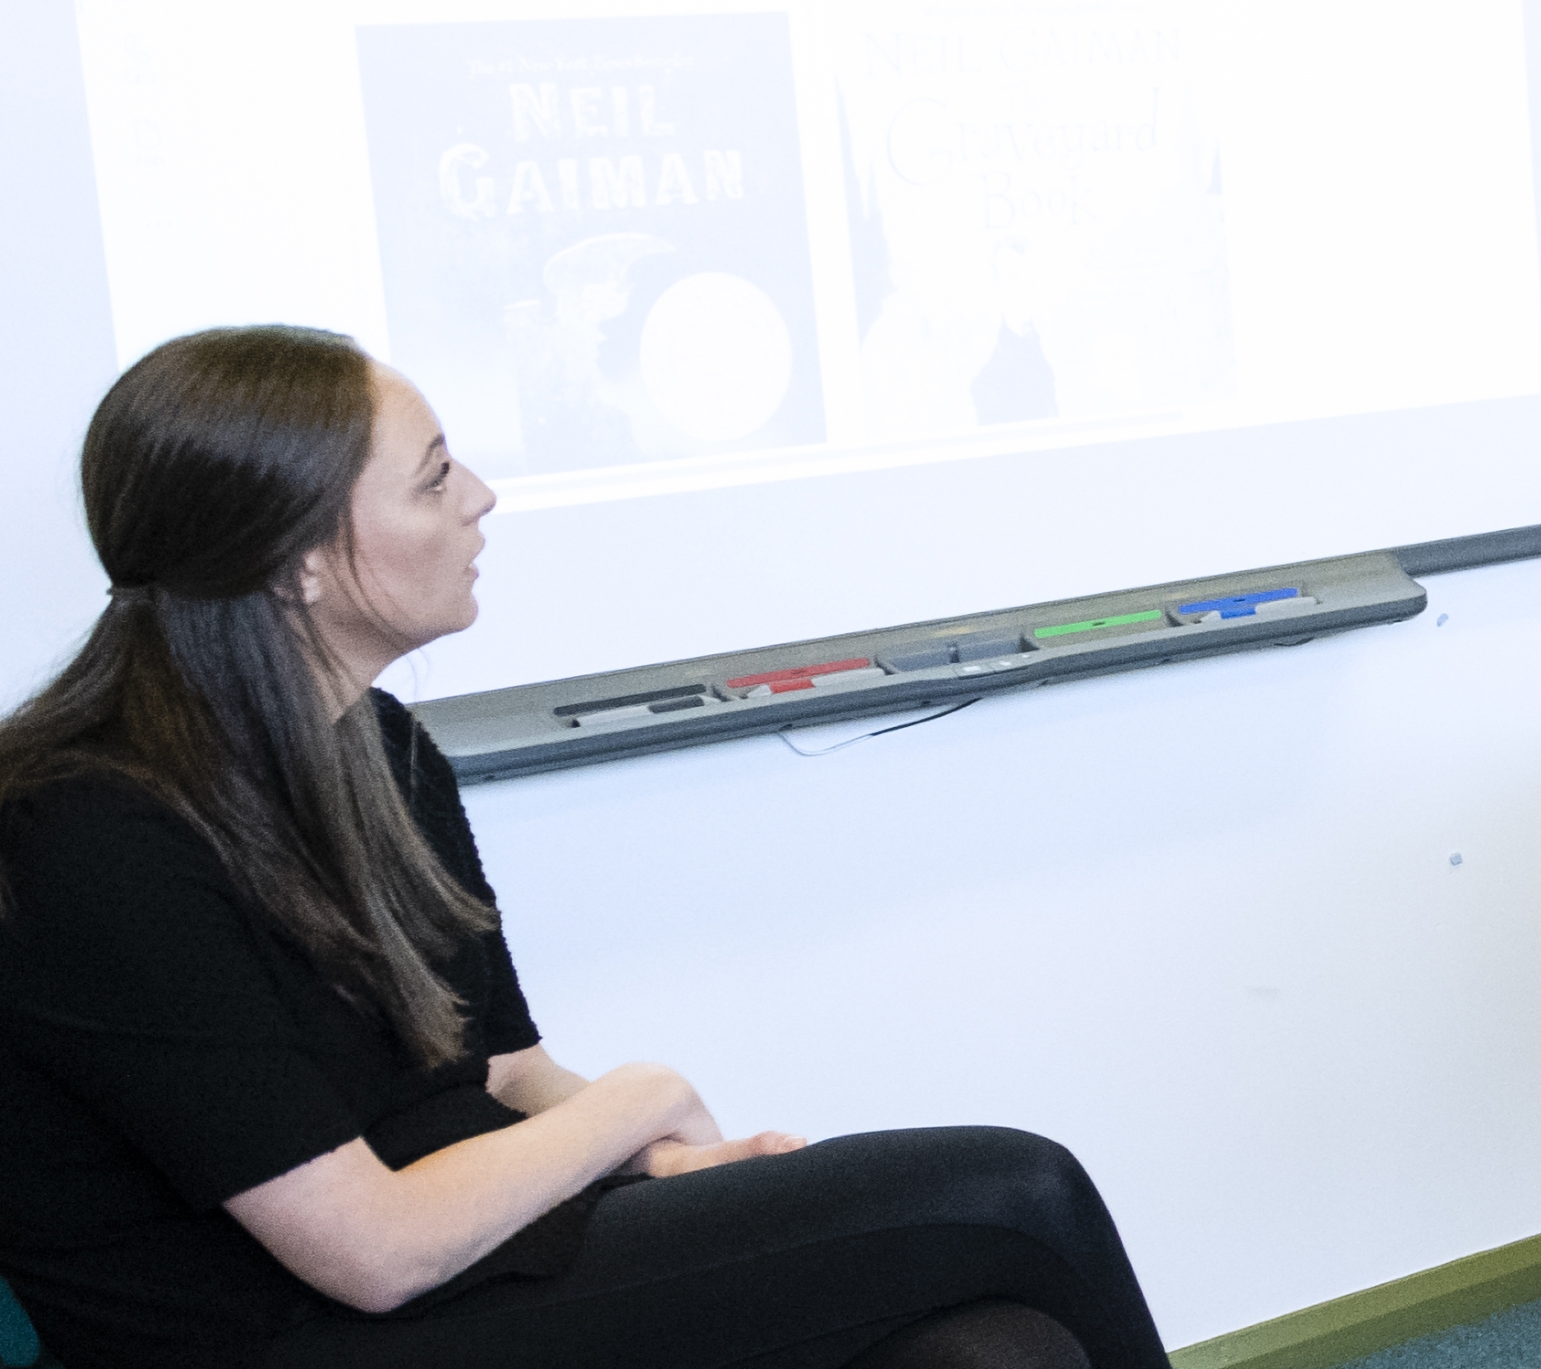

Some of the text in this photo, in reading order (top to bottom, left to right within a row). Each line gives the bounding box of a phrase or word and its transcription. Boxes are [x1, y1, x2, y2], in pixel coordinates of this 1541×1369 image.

[862, 26, 1182, 78] NEIL GAIMAN
[508, 82, 677, 143] NEIL
[438, 142, 745, 223] GAIMAN
